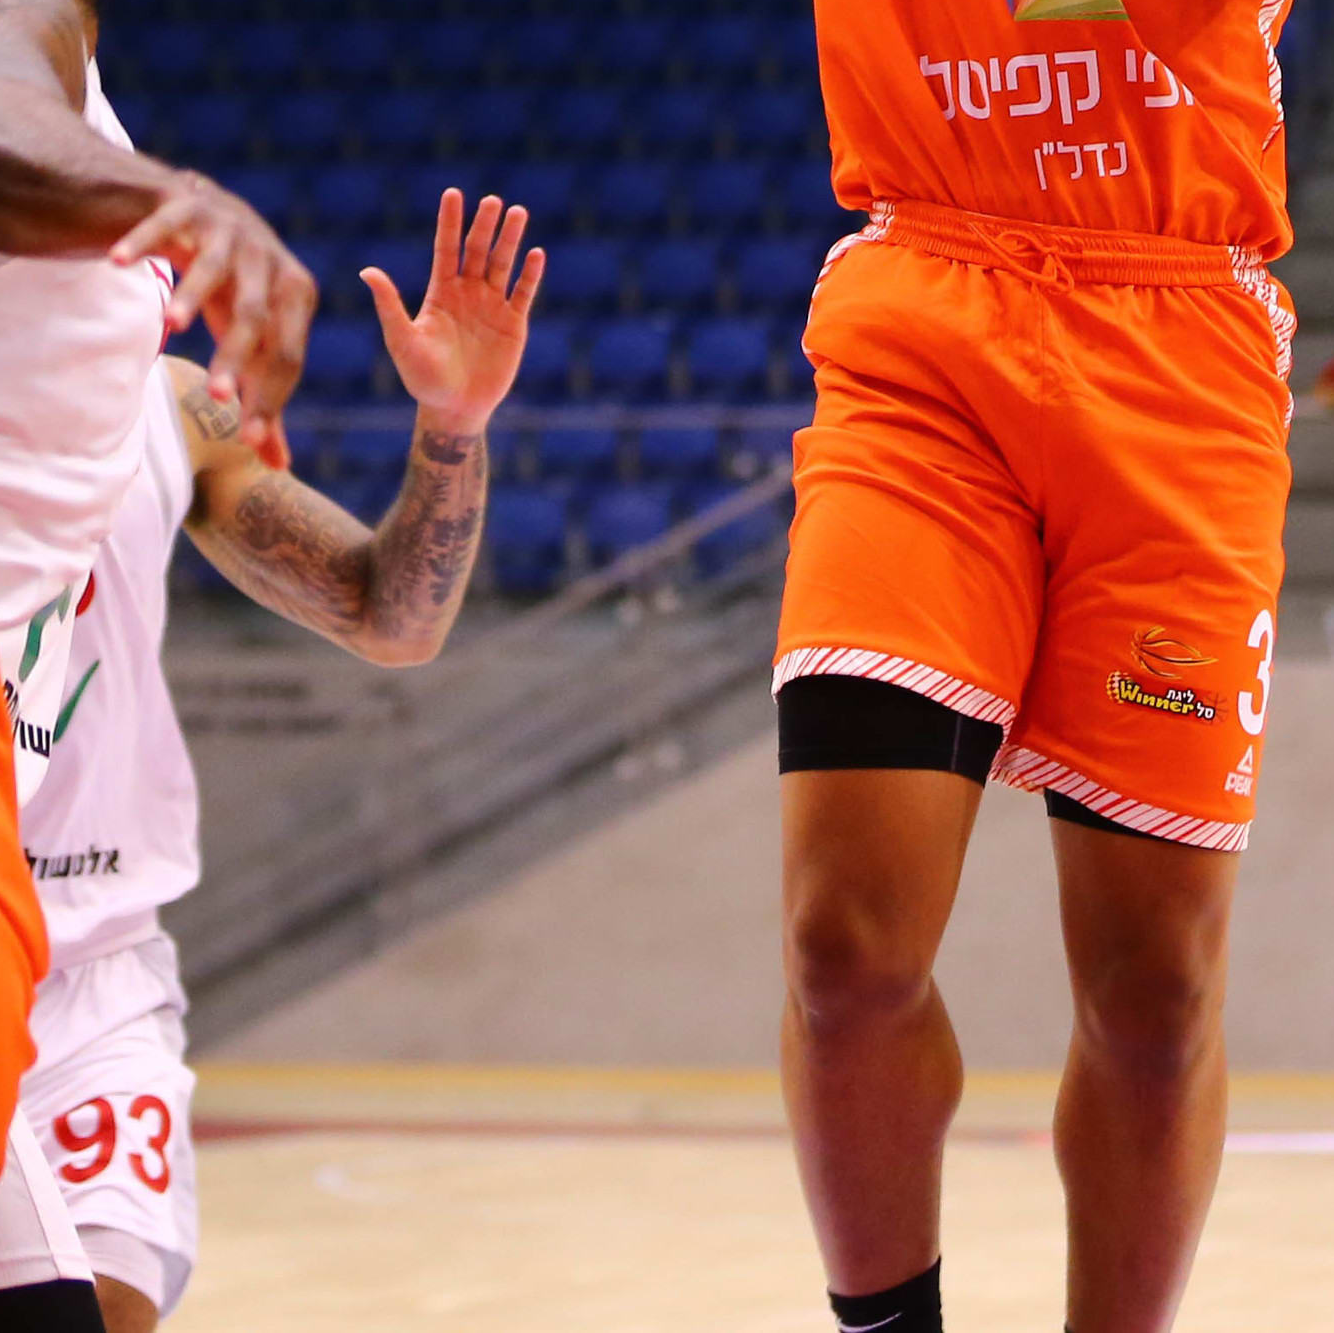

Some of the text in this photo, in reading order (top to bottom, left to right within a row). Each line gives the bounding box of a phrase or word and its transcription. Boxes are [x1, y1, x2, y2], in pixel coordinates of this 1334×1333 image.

[1237, 608, 1274, 736] 3
[1120, 680, 1194, 714] Winner
[1196, 702, 1215, 720] סל
[1224, 772, 1253, 797] PEAK
[53, 1094, 171, 1194] 93
